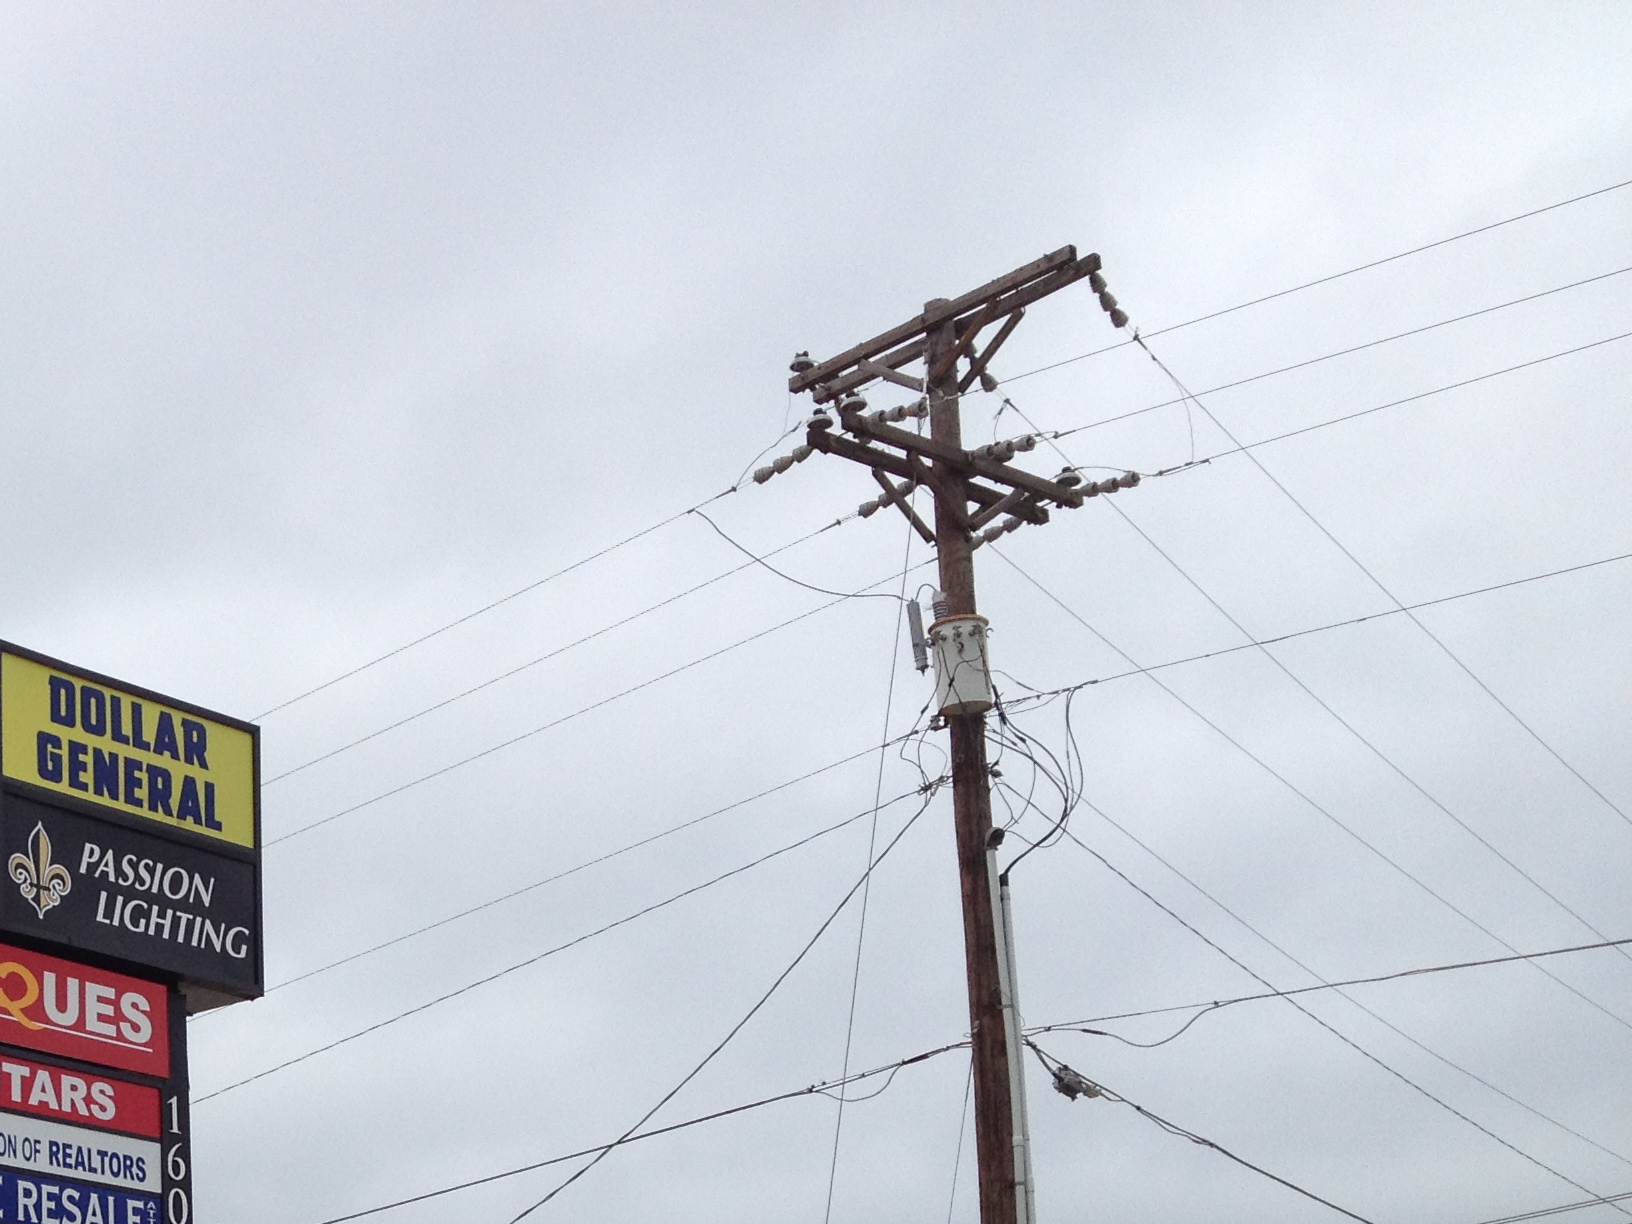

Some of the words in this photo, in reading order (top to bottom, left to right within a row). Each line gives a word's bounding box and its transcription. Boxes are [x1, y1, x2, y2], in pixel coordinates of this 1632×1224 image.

[48, 675, 209, 771] DOLLAR
[37, 735, 222, 831] GENERAL
[80, 843, 215, 908] PASSION
[96, 892, 249, 959] LIGHTING
[22, 1137, 41, 1162] OF
[49, 1141, 146, 1182] REALTORS
